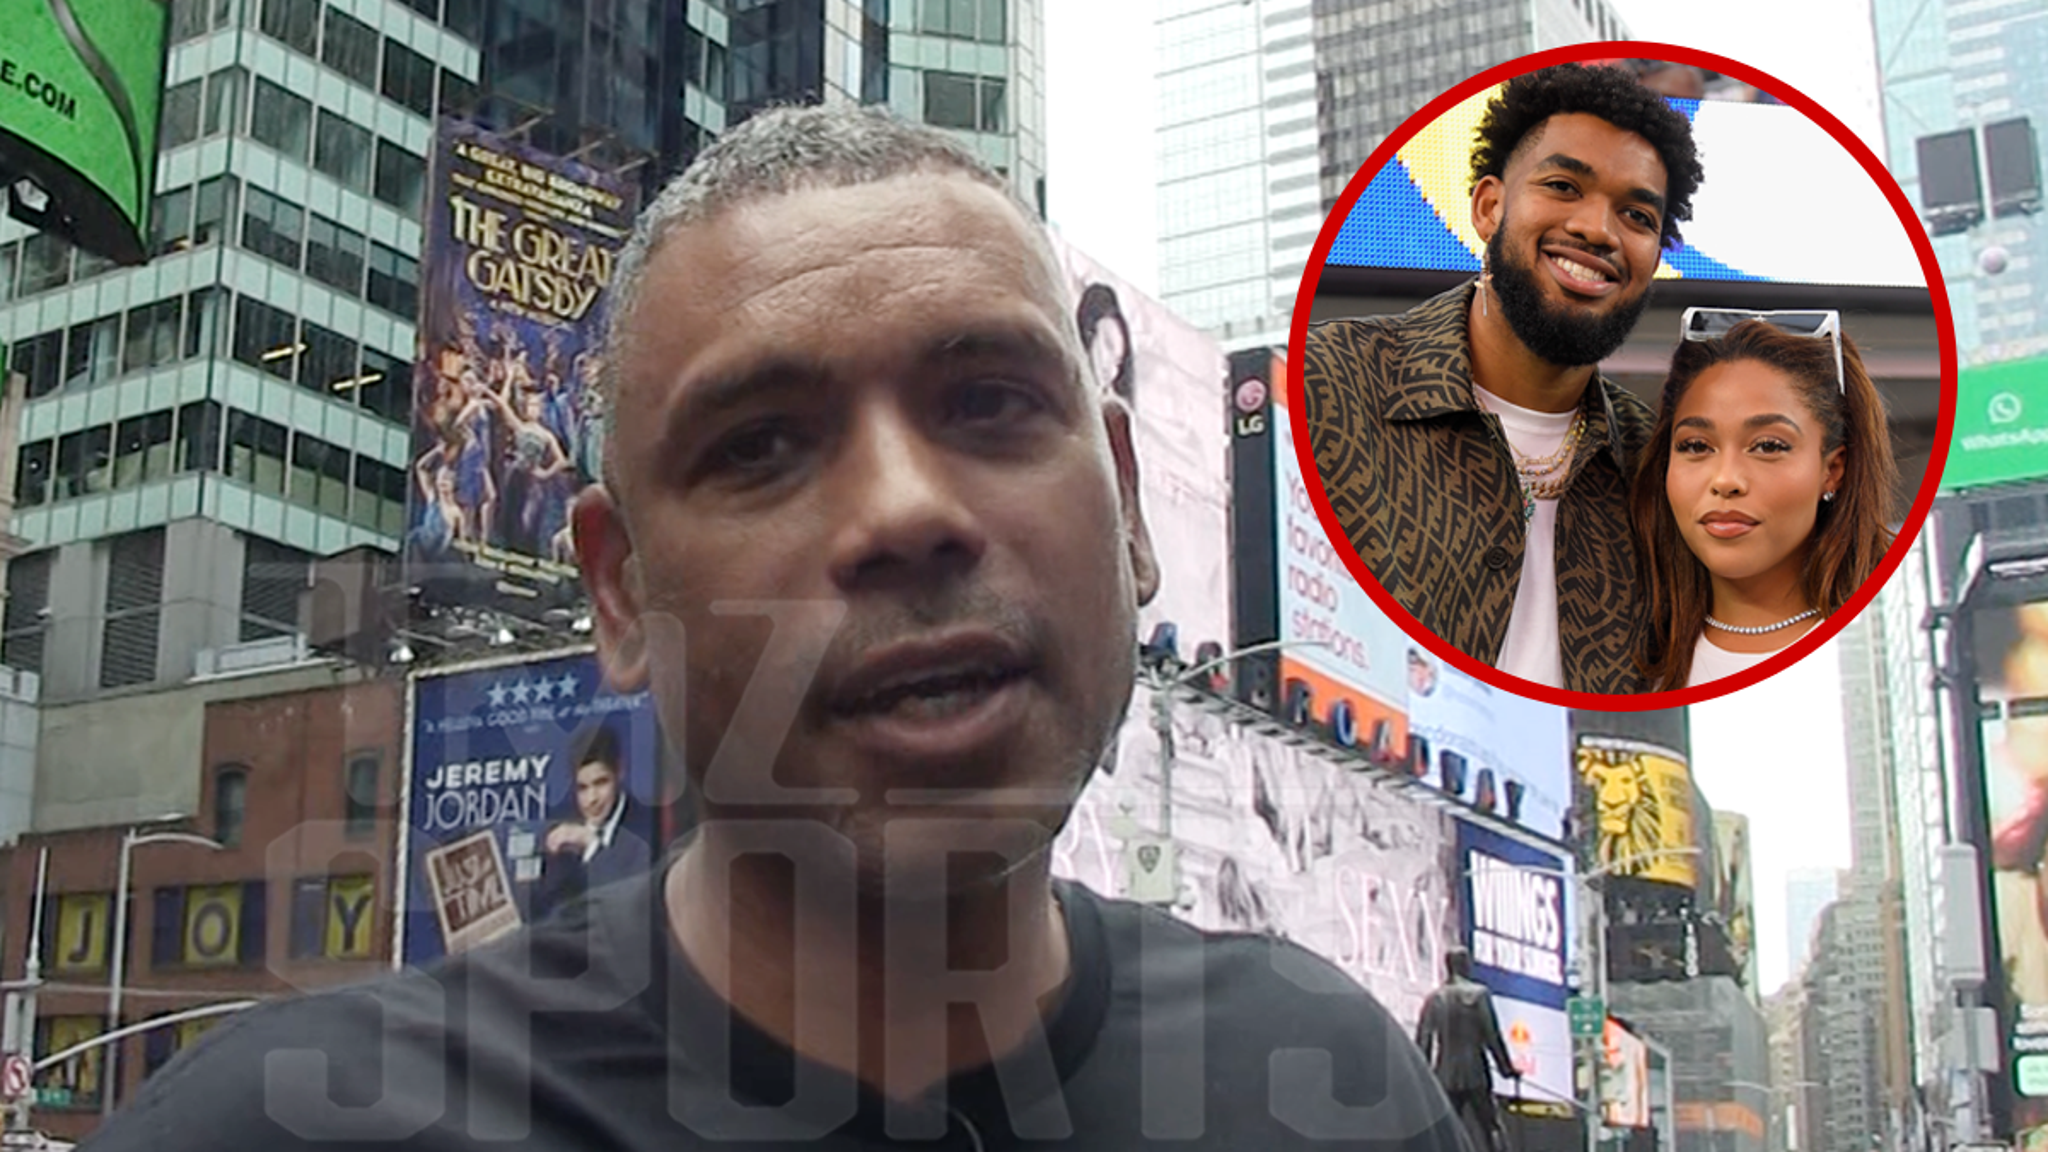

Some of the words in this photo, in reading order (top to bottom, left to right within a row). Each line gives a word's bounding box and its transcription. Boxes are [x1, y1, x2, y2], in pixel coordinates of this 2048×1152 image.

[450, 195, 508, 254] THE
[512, 222, 614, 287] GREAT
[466, 250, 600, 322] GATSBY
[1238, 415, 1265, 437] LG
[1287, 564, 1339, 613] radio
[425, 768, 548, 831] JORDAN
[426, 754, 551, 790] JEREMY
[1334, 864, 1449, 989] SEXY
